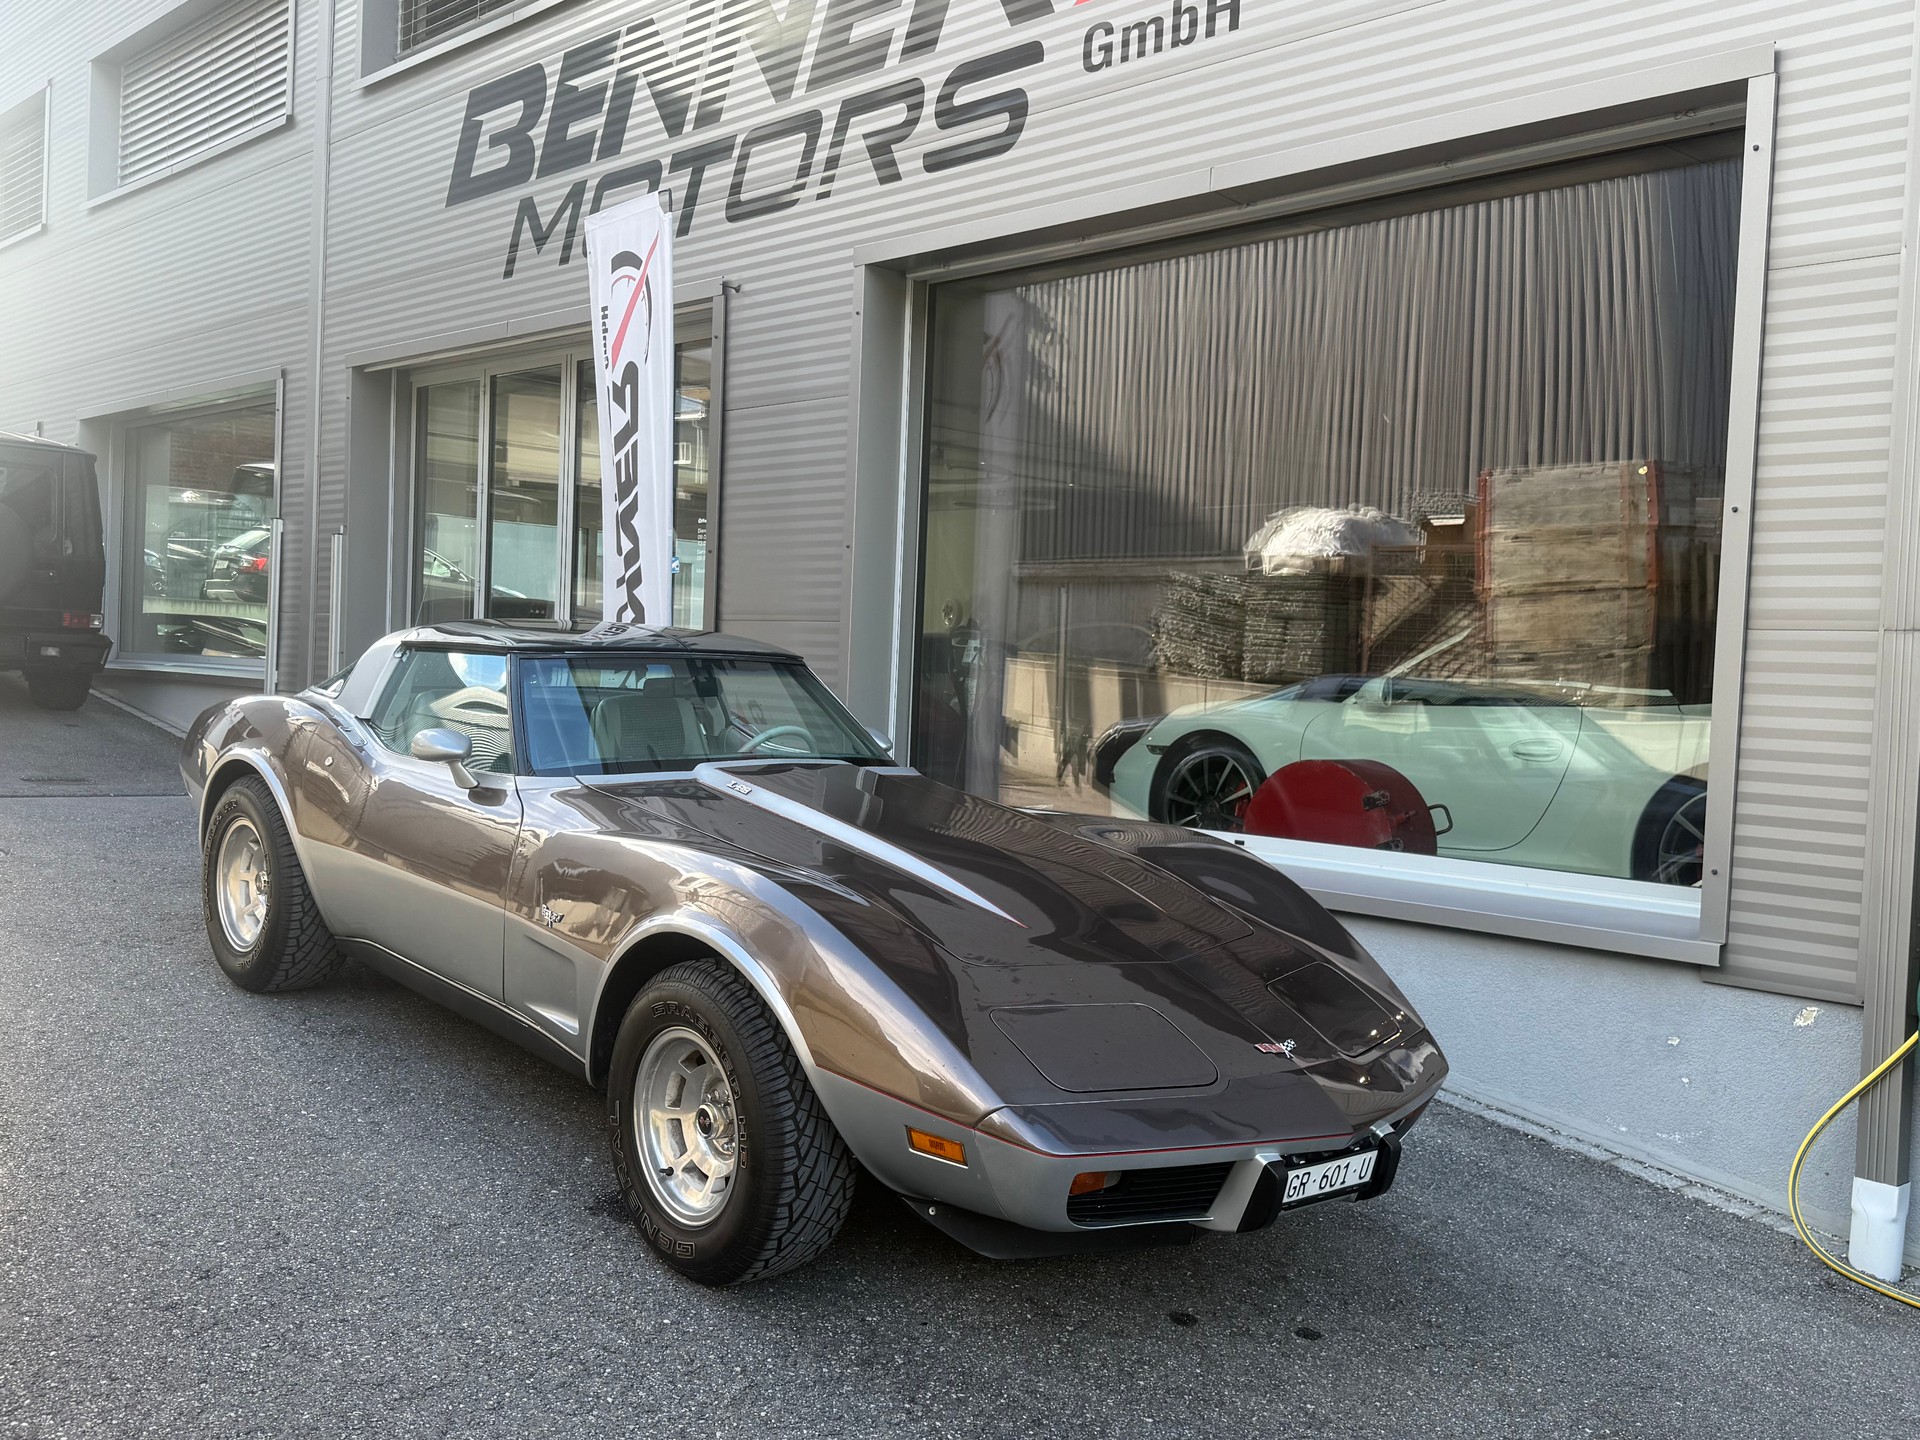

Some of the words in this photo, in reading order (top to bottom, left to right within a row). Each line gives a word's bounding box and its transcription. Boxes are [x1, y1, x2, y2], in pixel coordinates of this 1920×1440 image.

[1083, 0, 1241, 73] GmbH
[650, 1000, 741, 1100] GRABBER
[609, 1100, 695, 1259] GENERAL
